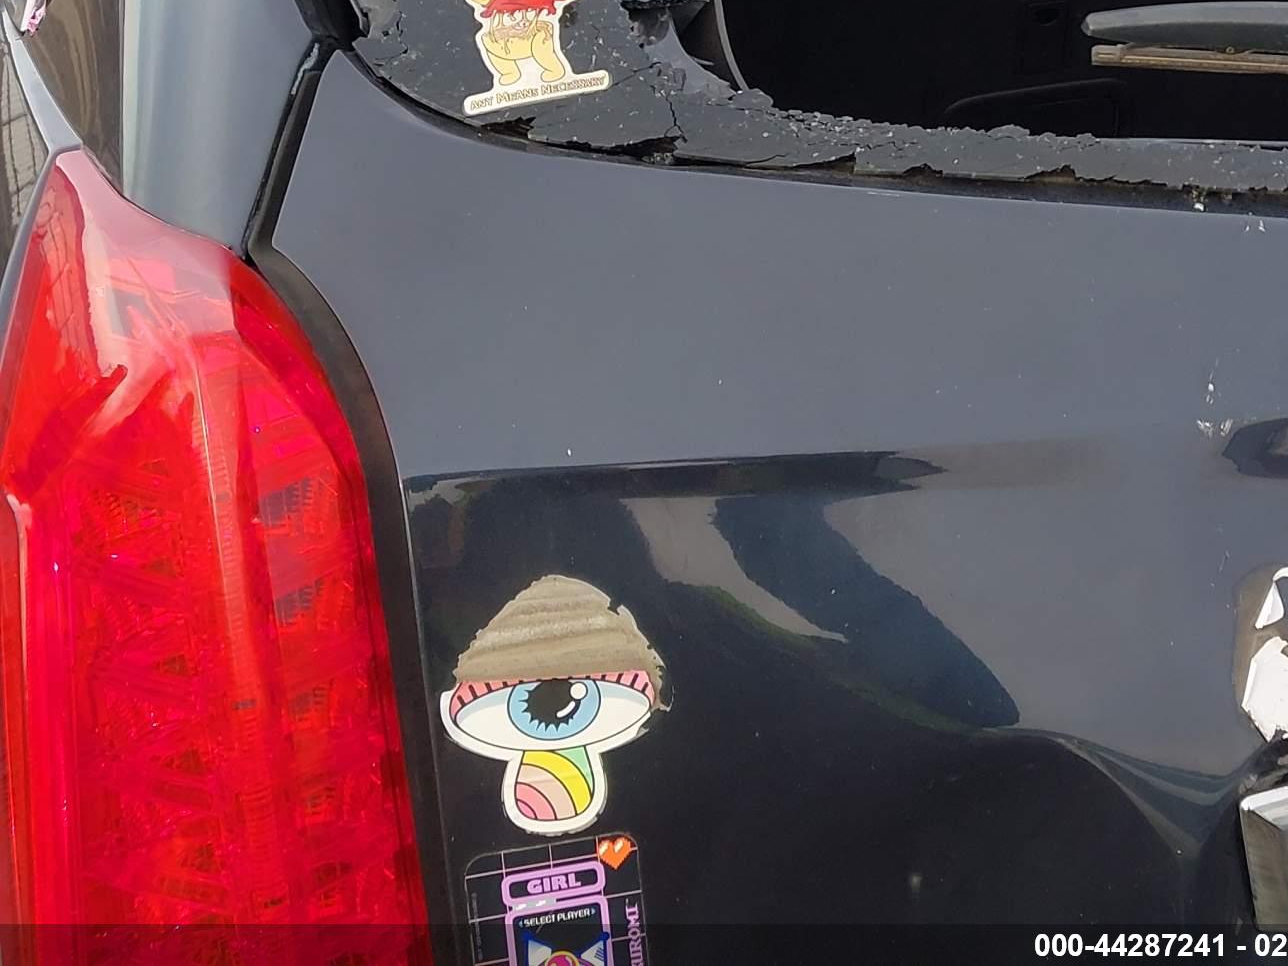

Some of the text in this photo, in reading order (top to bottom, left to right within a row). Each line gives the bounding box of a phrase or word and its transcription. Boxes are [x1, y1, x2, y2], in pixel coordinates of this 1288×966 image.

[527, 872, 582, 894] GIRL
[523, 907, 591, 928] SELECT PLAYER
